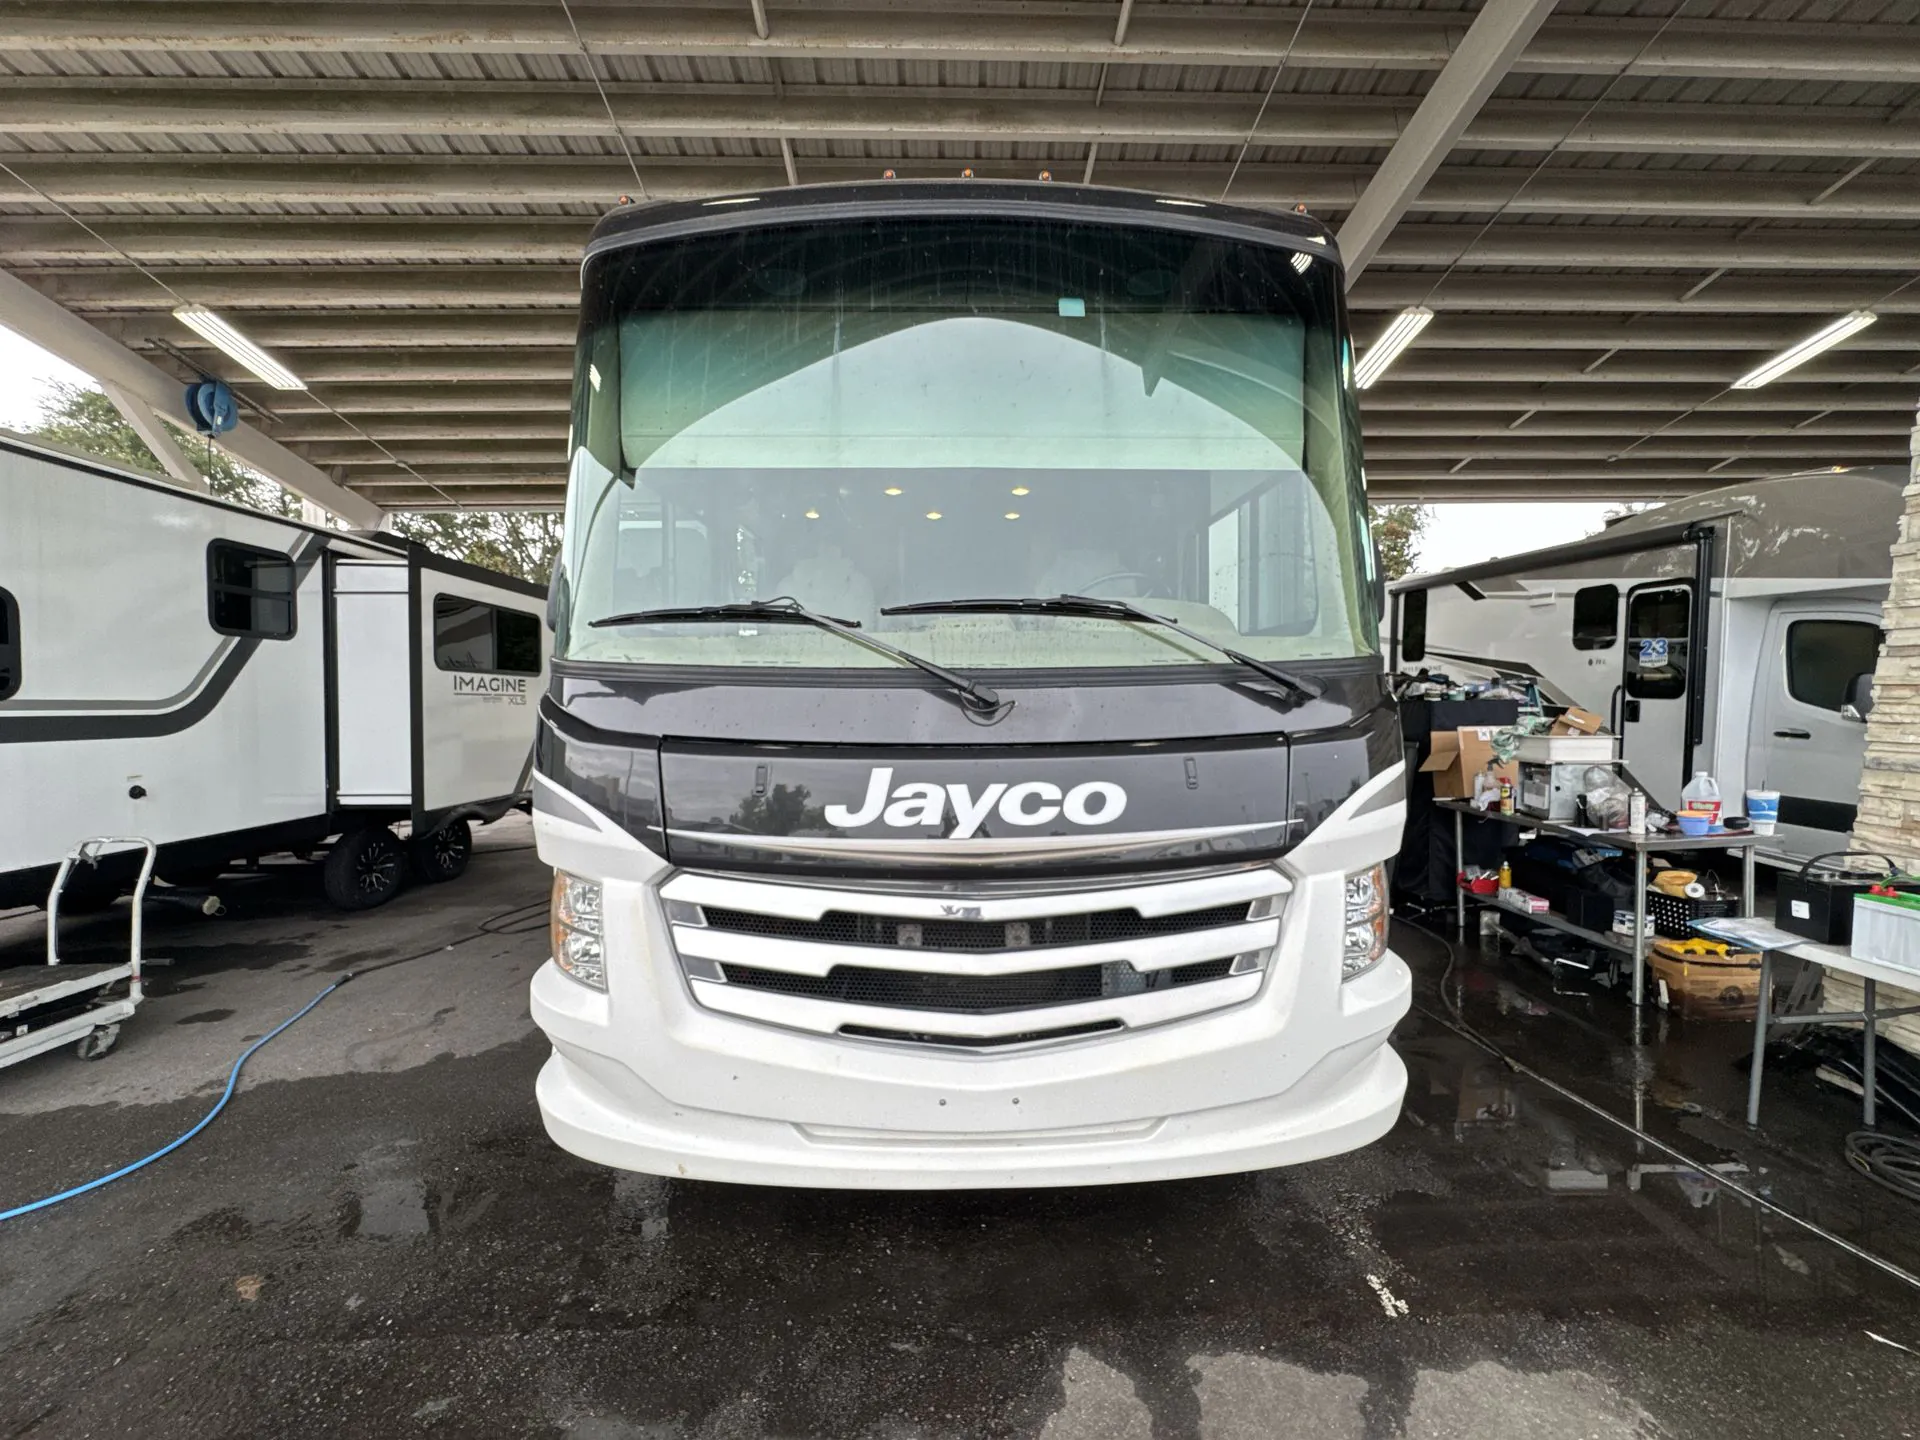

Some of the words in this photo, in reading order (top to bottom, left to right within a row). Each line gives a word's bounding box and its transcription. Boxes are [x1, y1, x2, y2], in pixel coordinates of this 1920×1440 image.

[453, 675, 527, 693] IMAGINE
[507, 695, 527, 706] XLS
[824, 767, 1128, 839] Jayco
